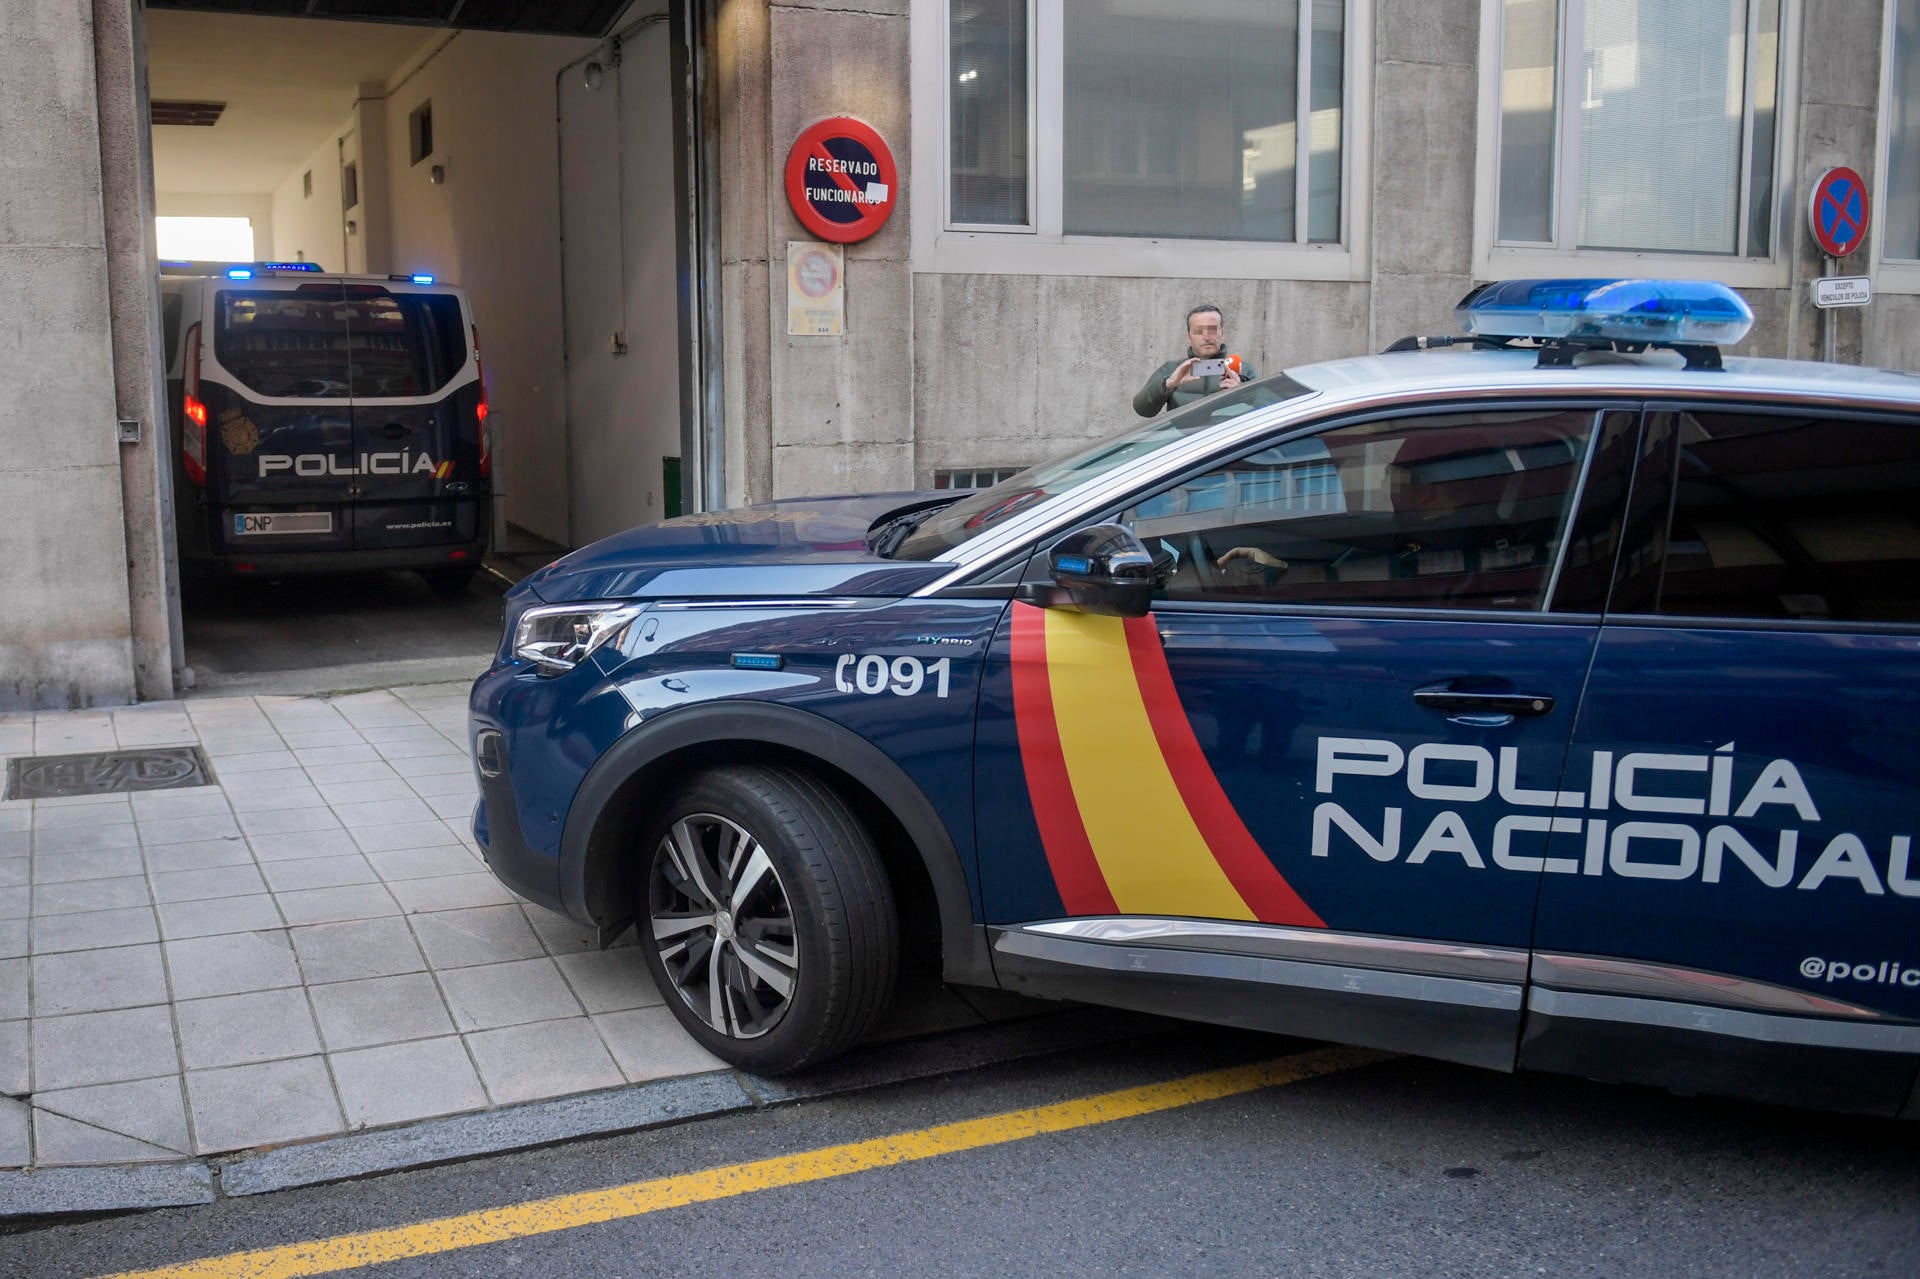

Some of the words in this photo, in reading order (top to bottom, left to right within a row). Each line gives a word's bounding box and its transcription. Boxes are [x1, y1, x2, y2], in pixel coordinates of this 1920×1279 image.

[809, 157, 877, 175] RESERVADO
[258, 447, 437, 477] POLICÍA
[244, 516, 272, 532] CNP
[386, 520, 452, 530] www.policia.es
[917, 636, 973, 646] HYBRID
[856, 654, 950, 698] 091
[1315, 736, 1821, 822] POLICÍA
